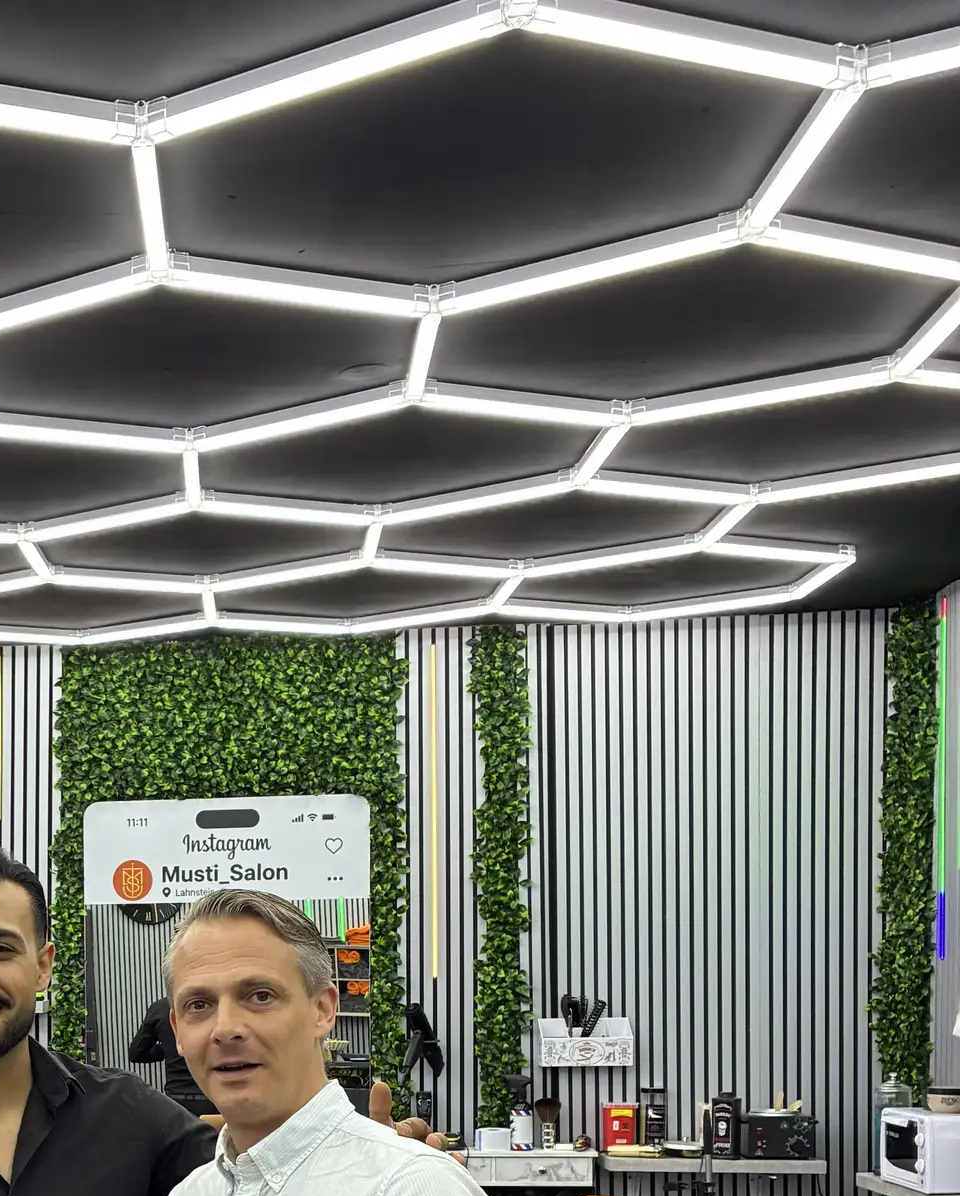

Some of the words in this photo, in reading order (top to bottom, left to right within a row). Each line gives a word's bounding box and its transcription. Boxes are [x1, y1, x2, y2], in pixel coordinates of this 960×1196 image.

[126, 817, 148, 827] 11:11
[182, 833, 272, 860] Instagram
[161, 863, 289, 884] Musti_Salon
